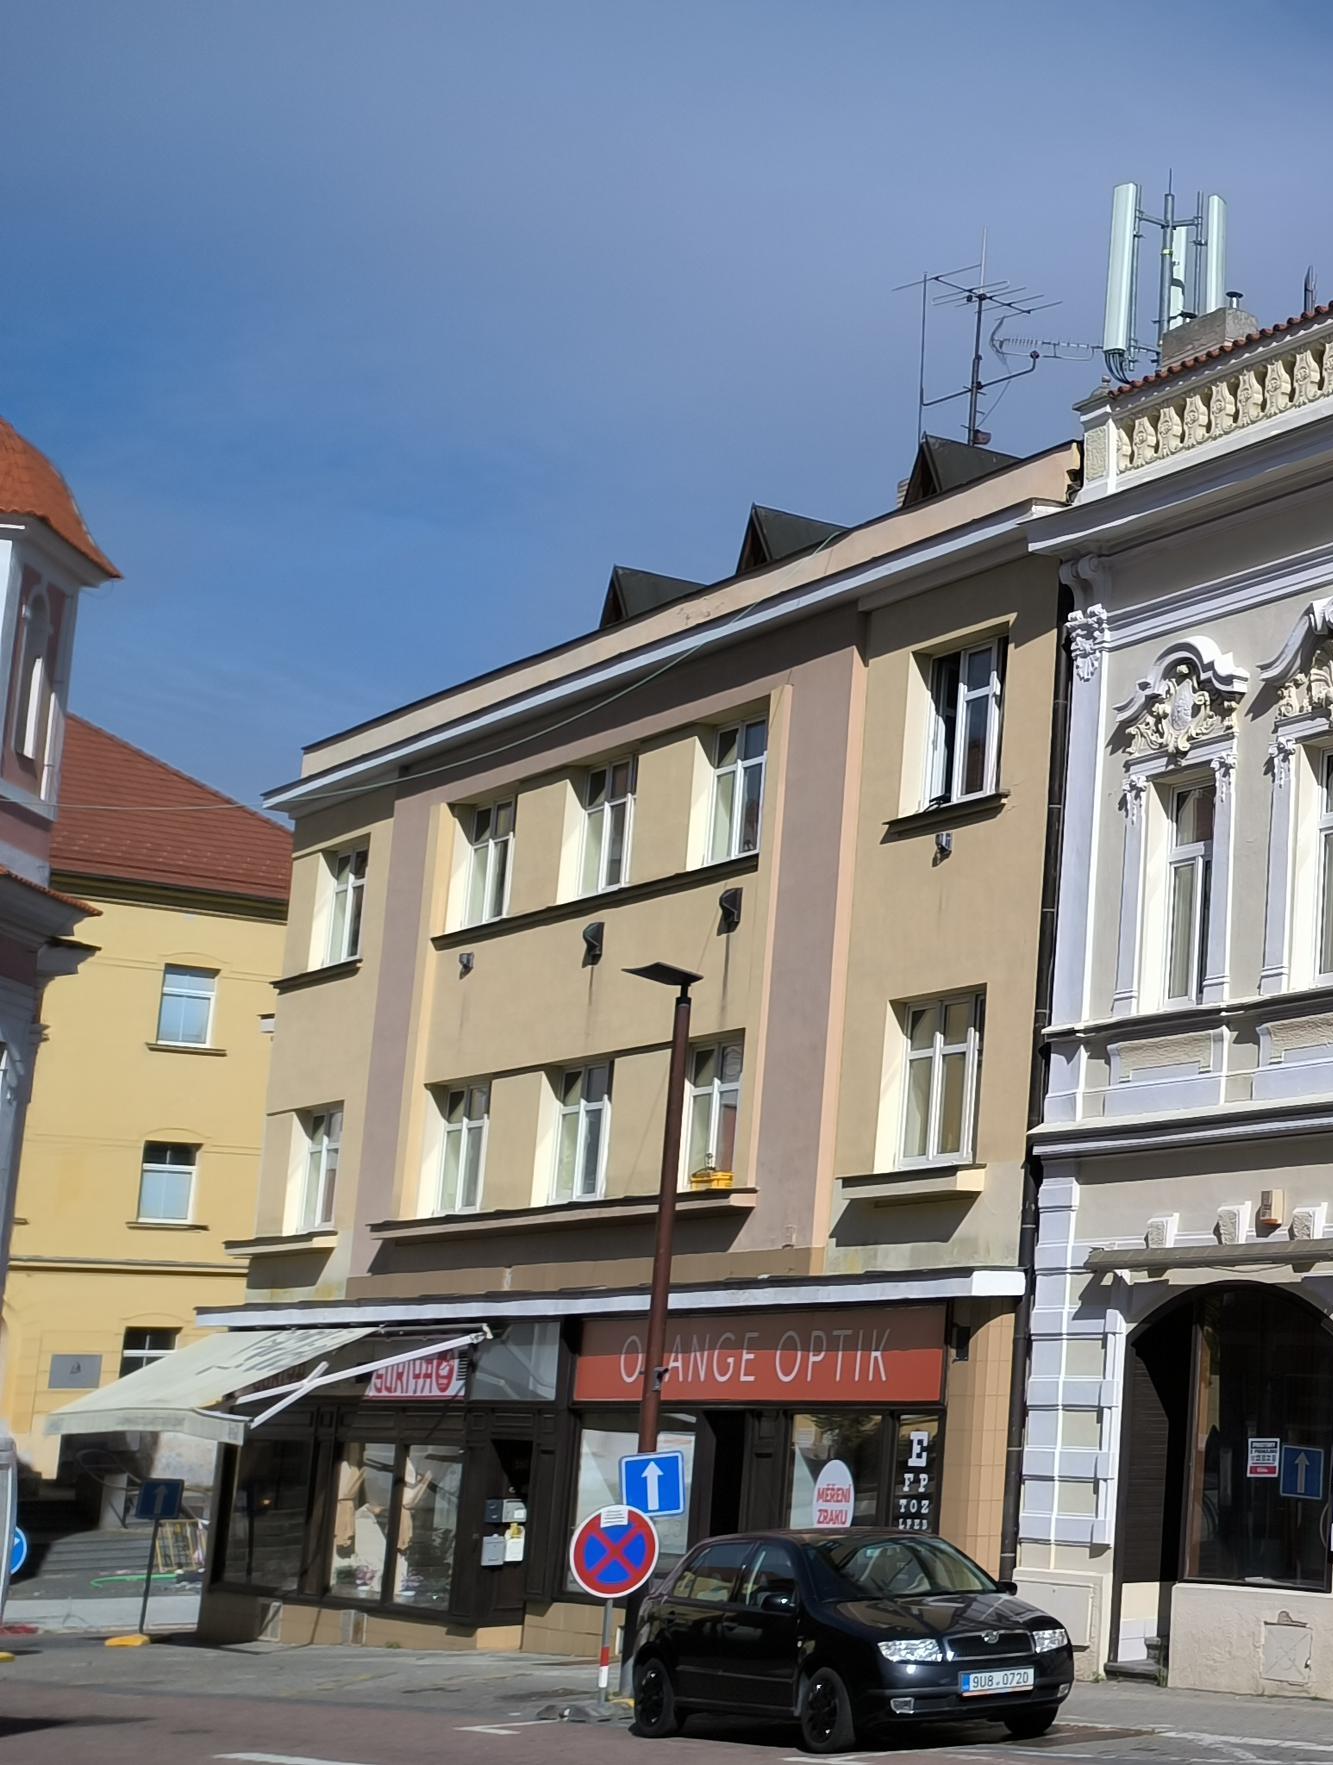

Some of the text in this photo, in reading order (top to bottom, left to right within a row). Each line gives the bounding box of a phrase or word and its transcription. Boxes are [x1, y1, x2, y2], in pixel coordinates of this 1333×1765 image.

[620, 1329, 891, 1383] OANGE OPTIK
[907, 1431, 929, 1467] E
[817, 1483, 852, 1503] MĚŘENÍ
[816, 1509, 848, 1525] ZRAKU
[972, 1671, 1029, 1689] 9U8 0720
